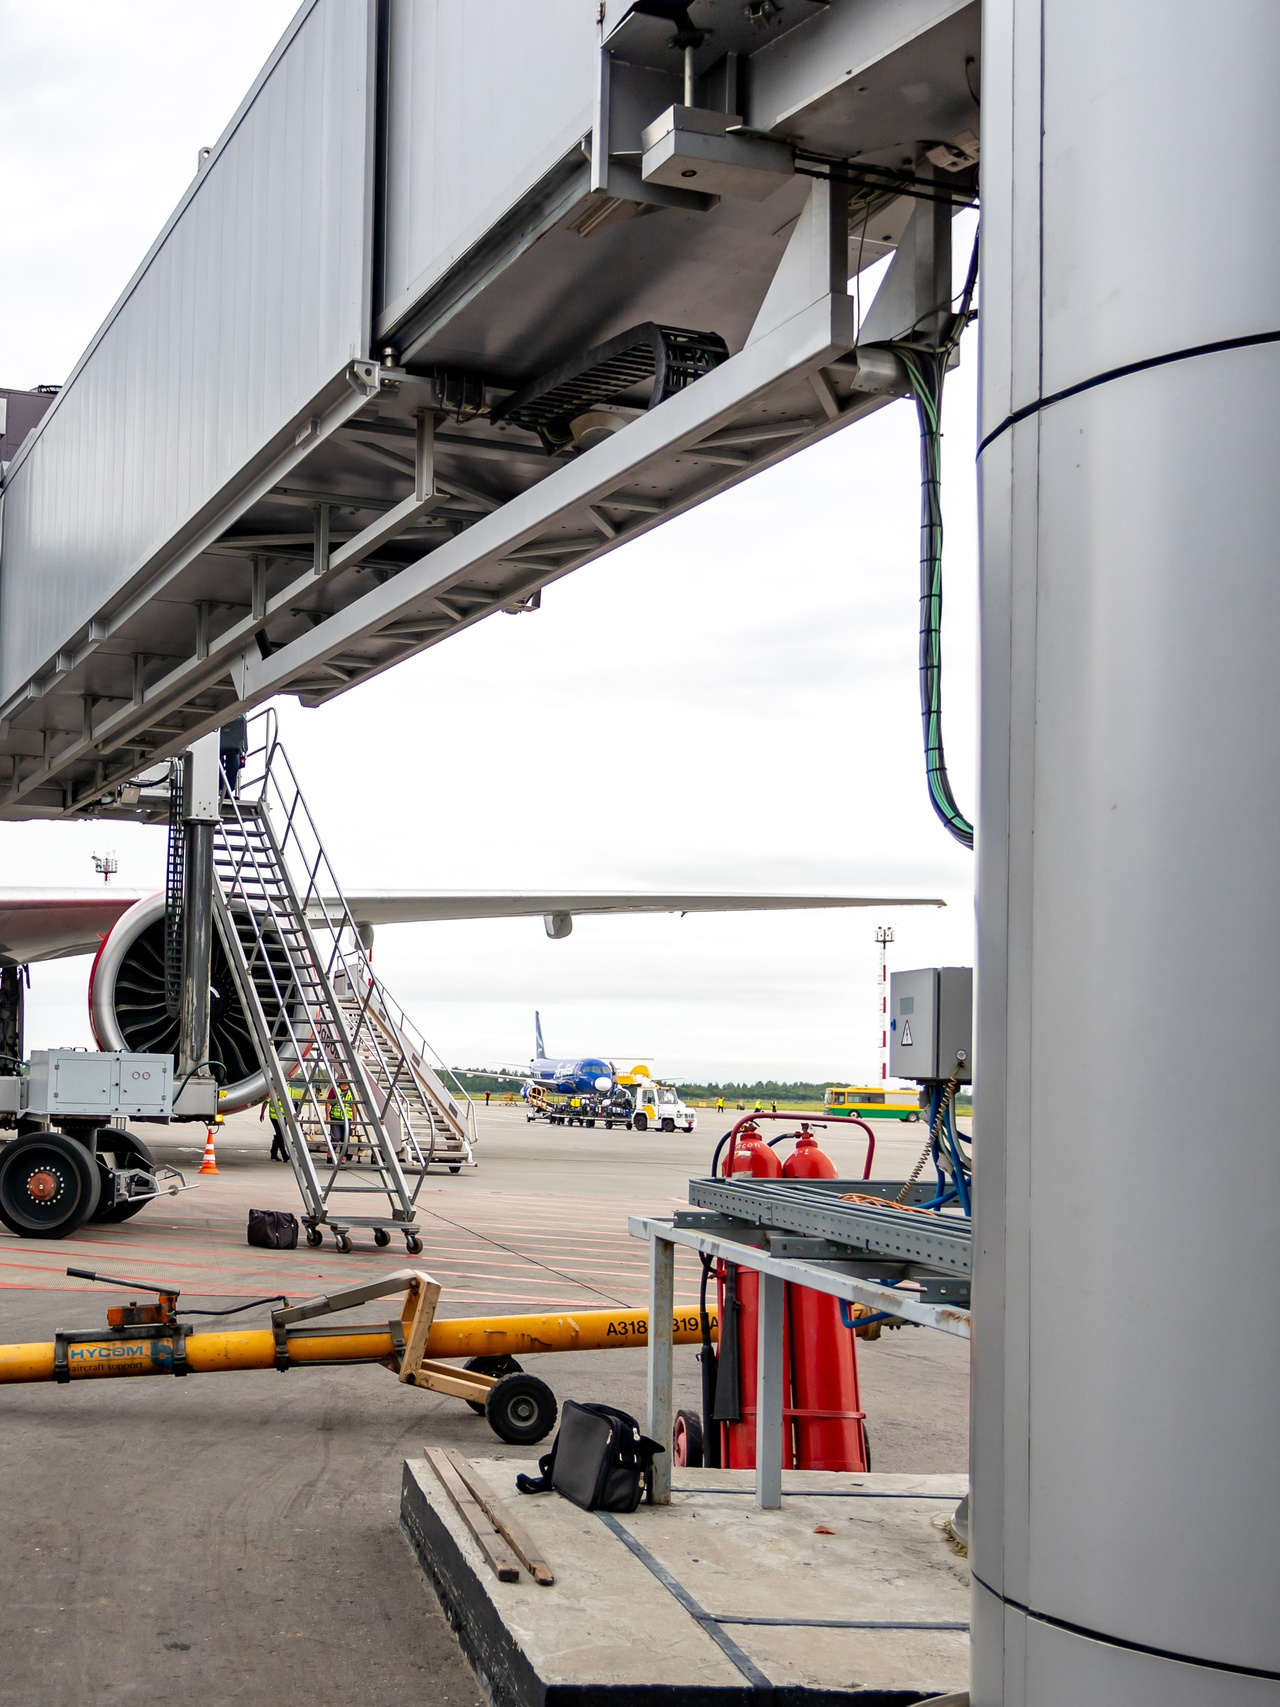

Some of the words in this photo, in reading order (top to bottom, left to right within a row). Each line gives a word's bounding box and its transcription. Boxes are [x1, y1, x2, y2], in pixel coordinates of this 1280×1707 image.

[606, 1320, 648, 1336] A318
[71, 1346, 143, 1359] HYCOM
[71, 1362, 105, 1373] aircraft
[107, 1361, 144, 1372] support
